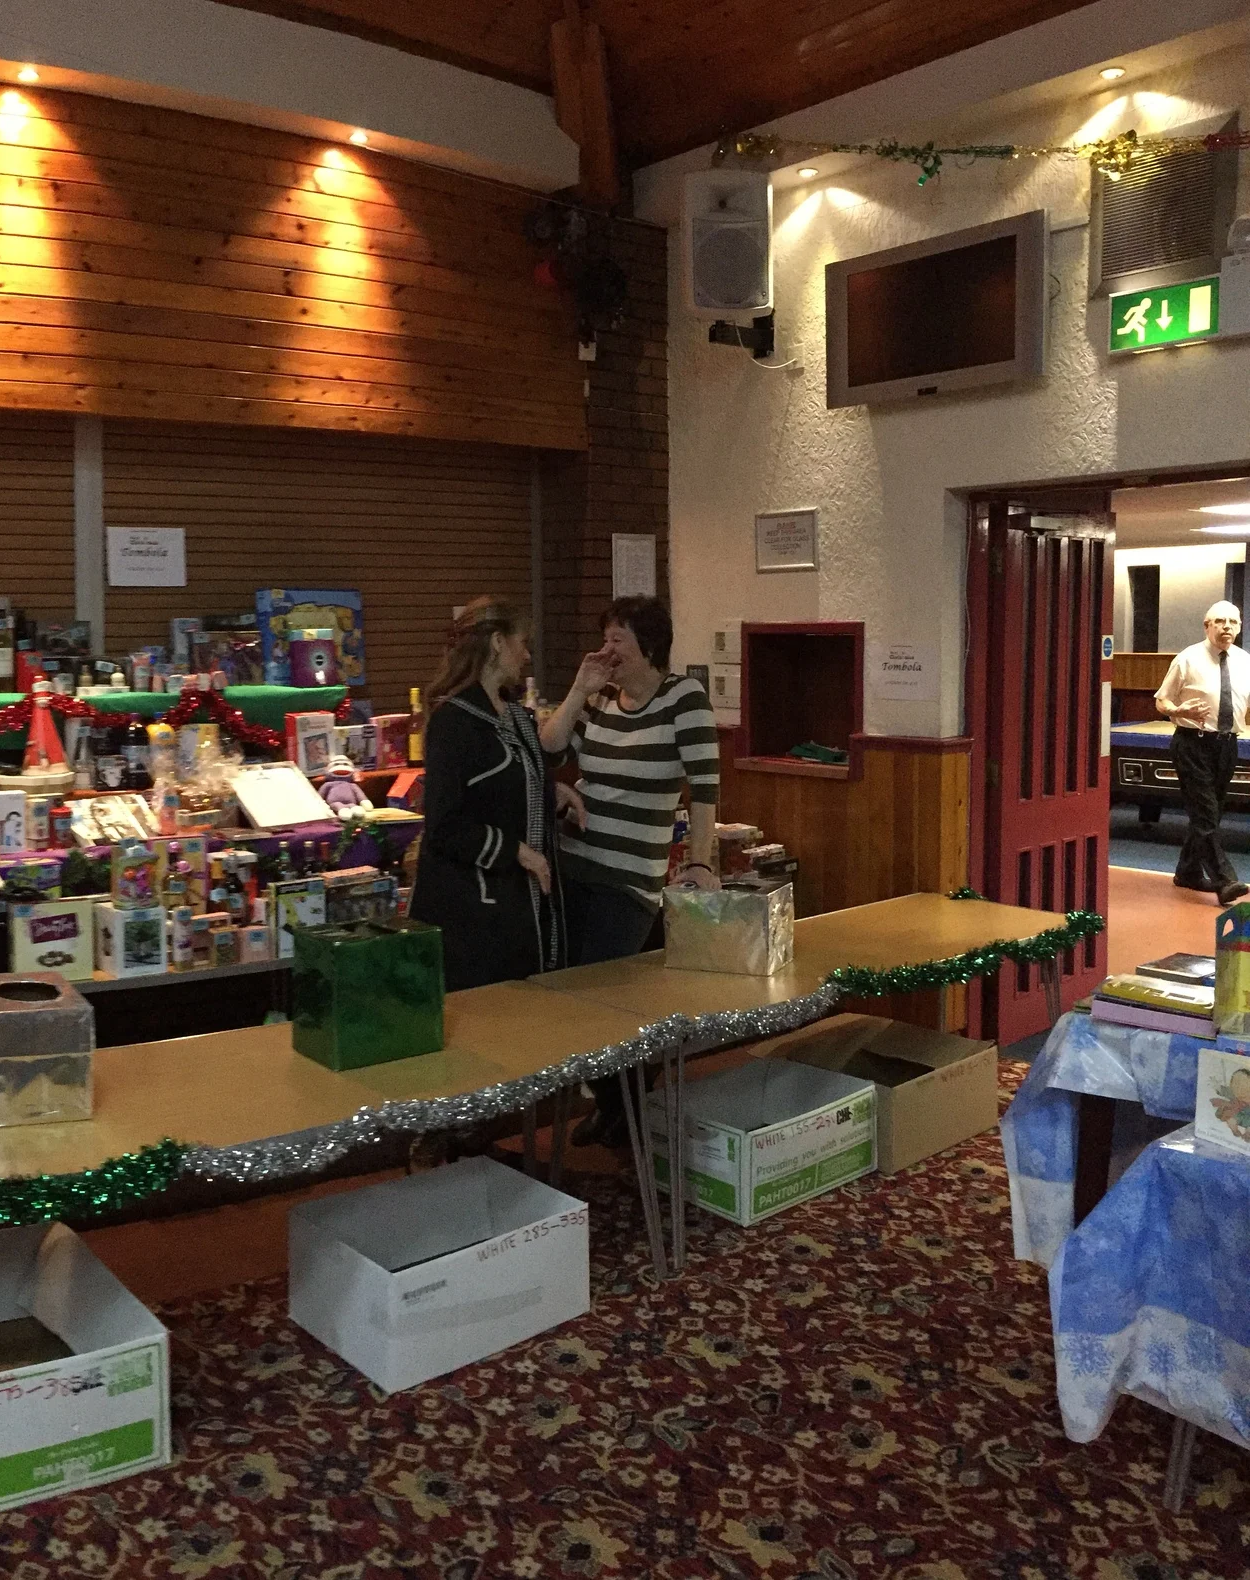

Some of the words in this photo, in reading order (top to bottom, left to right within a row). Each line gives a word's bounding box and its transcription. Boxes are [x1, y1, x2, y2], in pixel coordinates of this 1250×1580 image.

[882, 661, 922, 672] Tombola
[754, 1129, 787, 1150] WHITE
[756, 1156, 800, 1177] Providing
[802, 1148, 818, 1160] you
[476, 1233, 517, 1262] WHITE
[522, 1207, 588, 1243] 285-335
